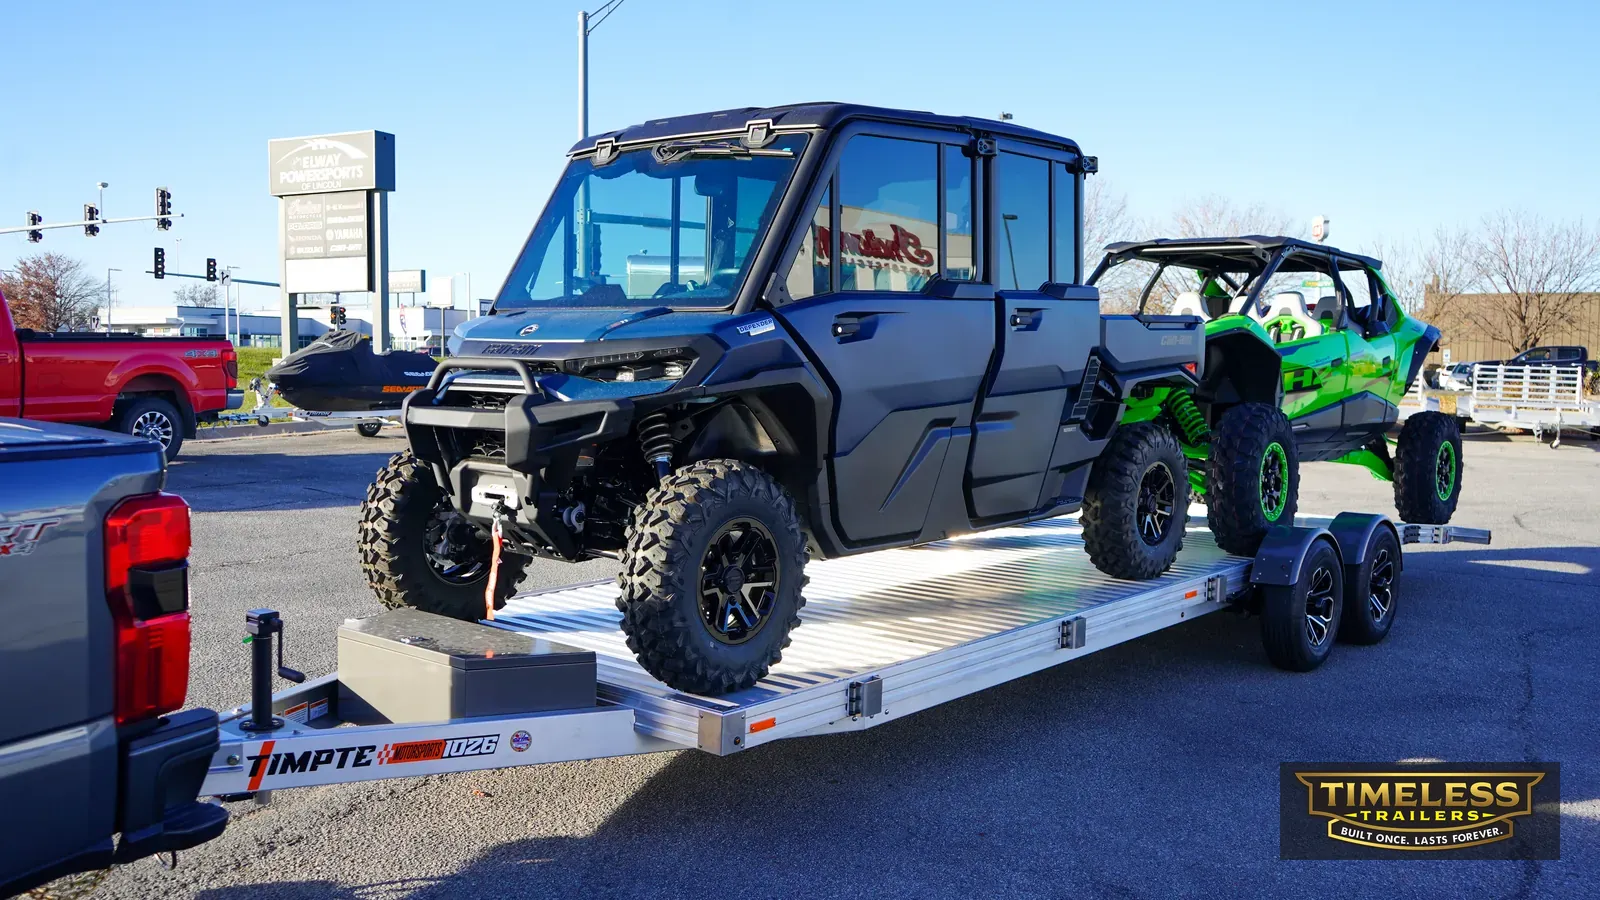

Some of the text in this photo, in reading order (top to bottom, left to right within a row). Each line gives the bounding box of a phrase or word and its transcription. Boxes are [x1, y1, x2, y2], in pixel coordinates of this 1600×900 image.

[302, 153, 342, 169] ELWAY
[279, 165, 364, 184] POWERSPORTS
[301, 180, 342, 191] OF LINCOLN
[334, 227, 363, 240] YAMAHA
[739, 318, 773, 333] DEFENDER
[246, 741, 376, 787] TIMPTE
[393, 741, 443, 761] MOTORSPORTS
[442, 735, 499, 758] 1026
